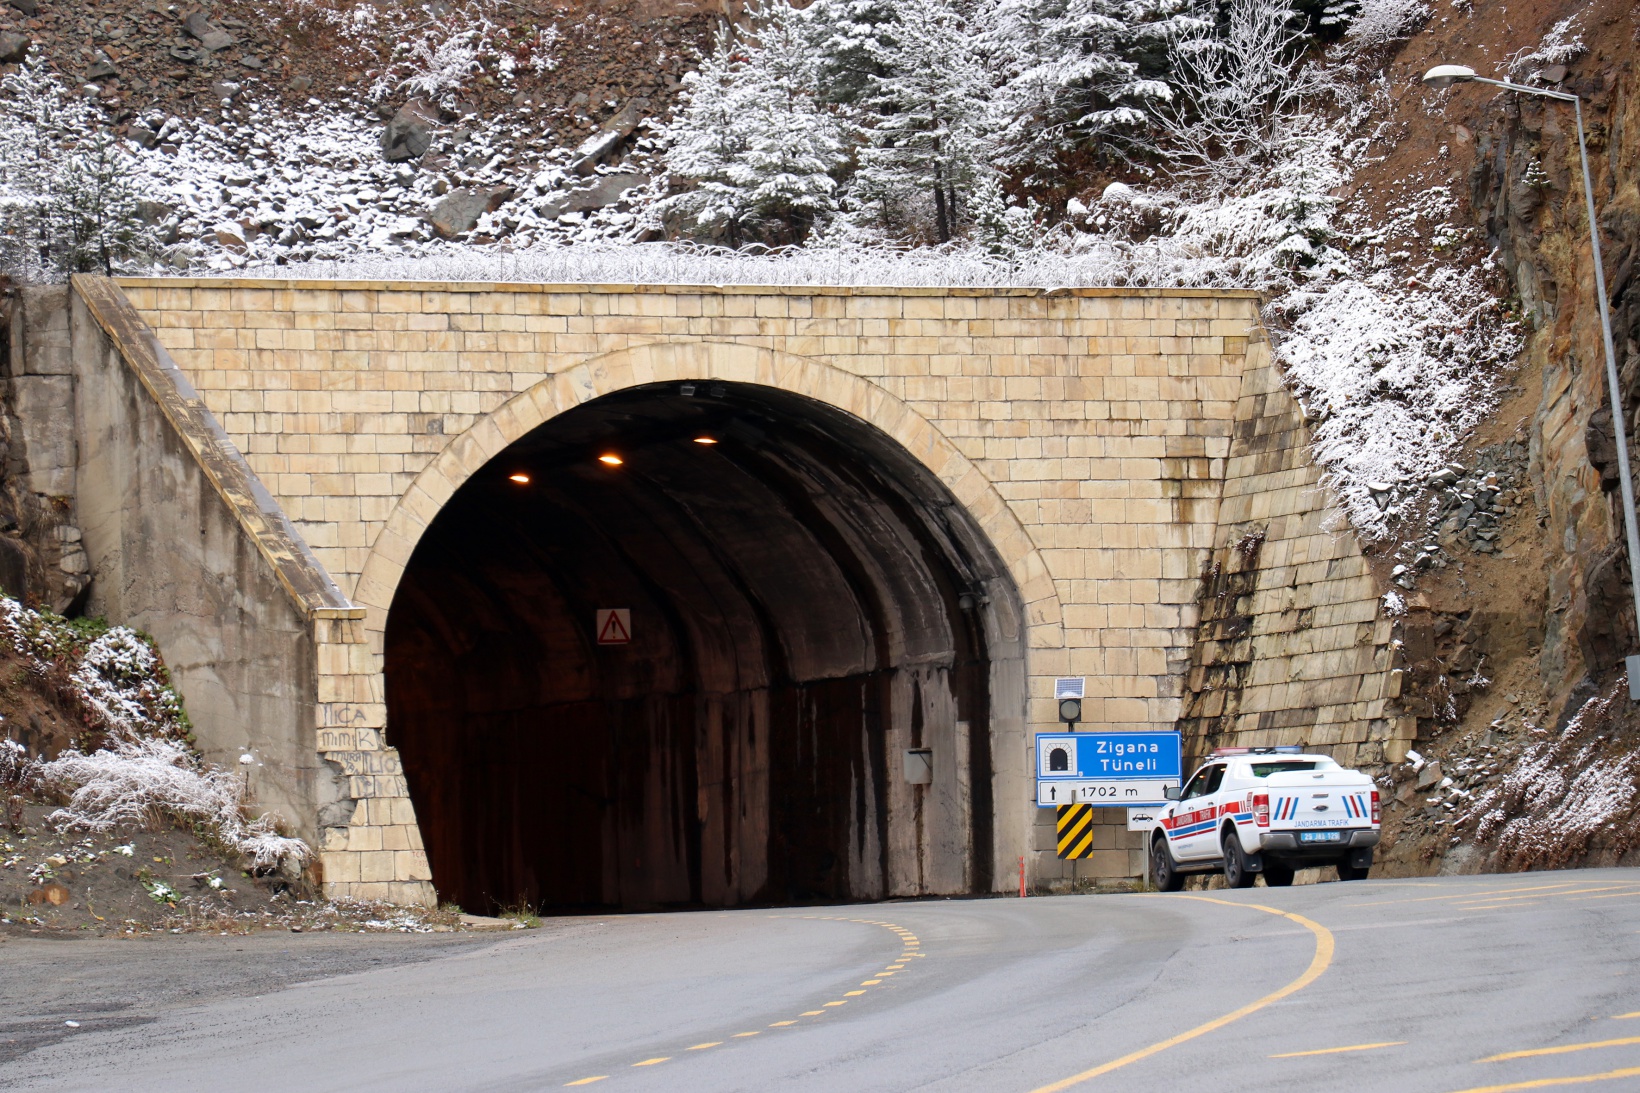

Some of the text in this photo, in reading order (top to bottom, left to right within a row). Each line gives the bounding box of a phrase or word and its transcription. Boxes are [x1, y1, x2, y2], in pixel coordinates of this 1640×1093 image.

[1096, 741, 1159, 756] Zigana
[1100, 758, 1157, 771] Tüneli
[1081, 786, 1138, 797] 1702 m
[1294, 820, 1327, 828] JANDARMA
